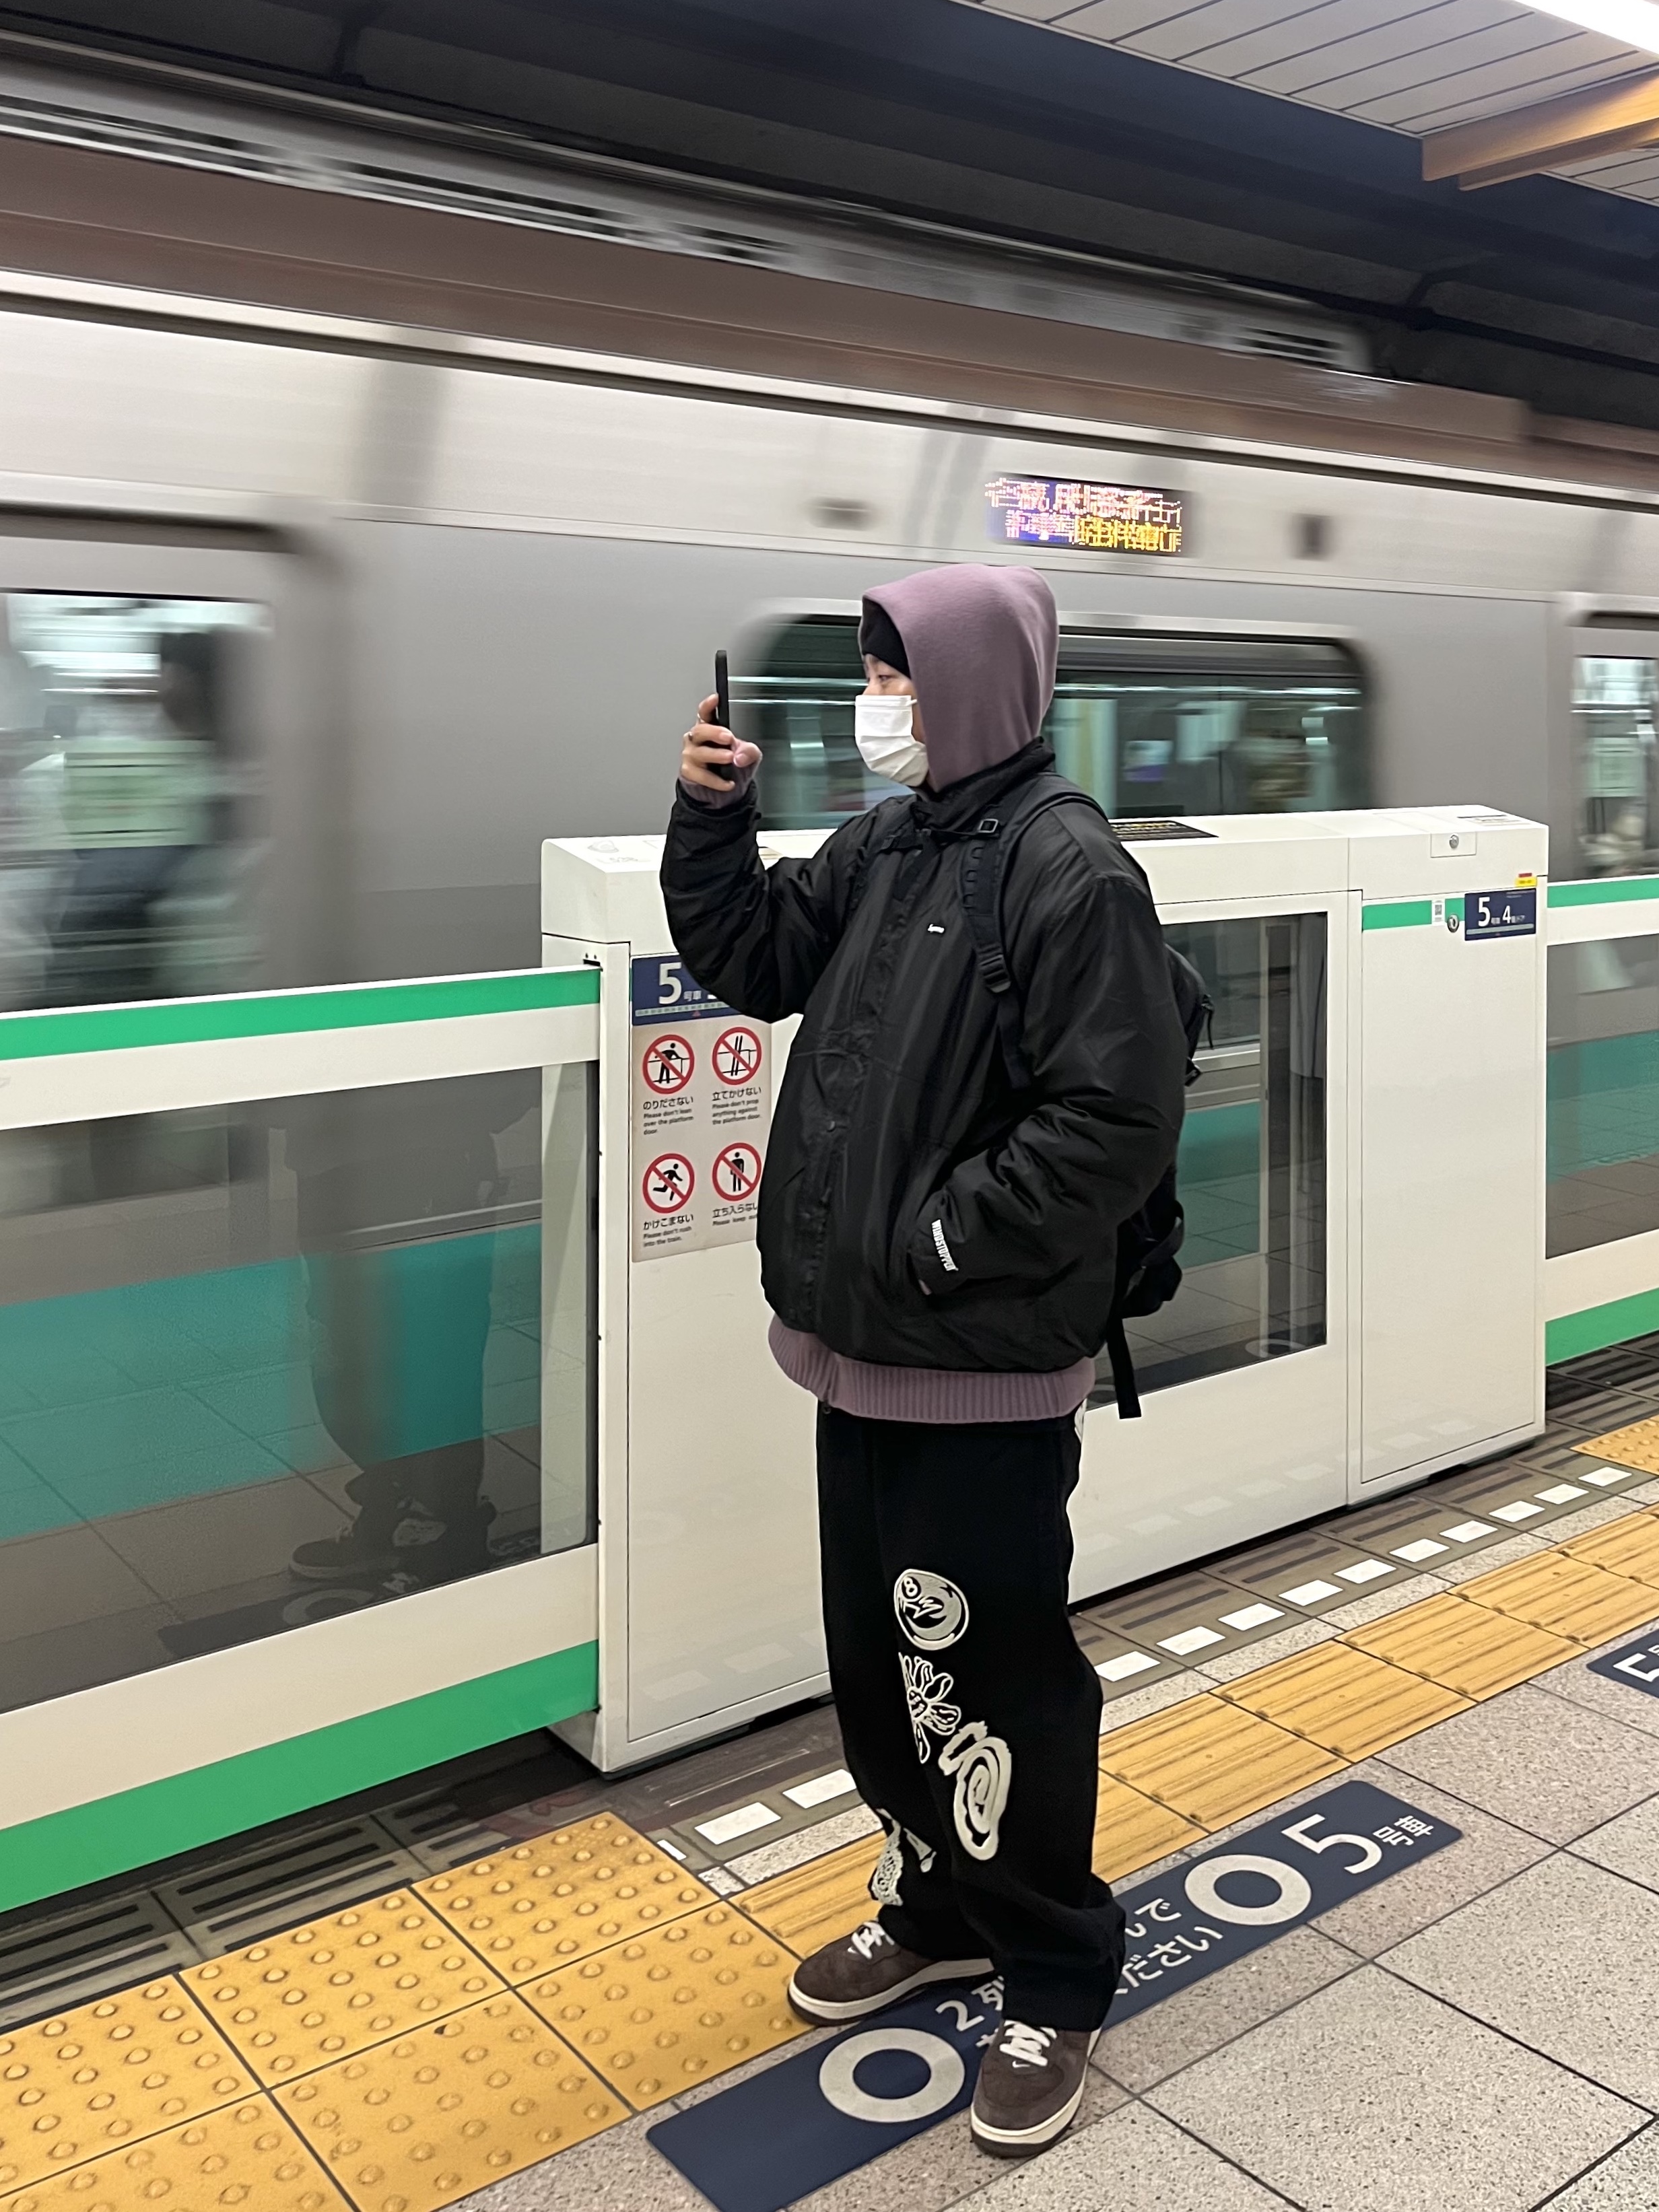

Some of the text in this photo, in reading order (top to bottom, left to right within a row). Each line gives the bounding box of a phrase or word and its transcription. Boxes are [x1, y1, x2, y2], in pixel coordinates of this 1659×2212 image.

[712, 1086, 762, 1101] 立てかけない
[643, 1096, 694, 1110] のりださない
[669, 1115, 694, 1125] platform
[643, 1214, 694, 1231] かけこまない
